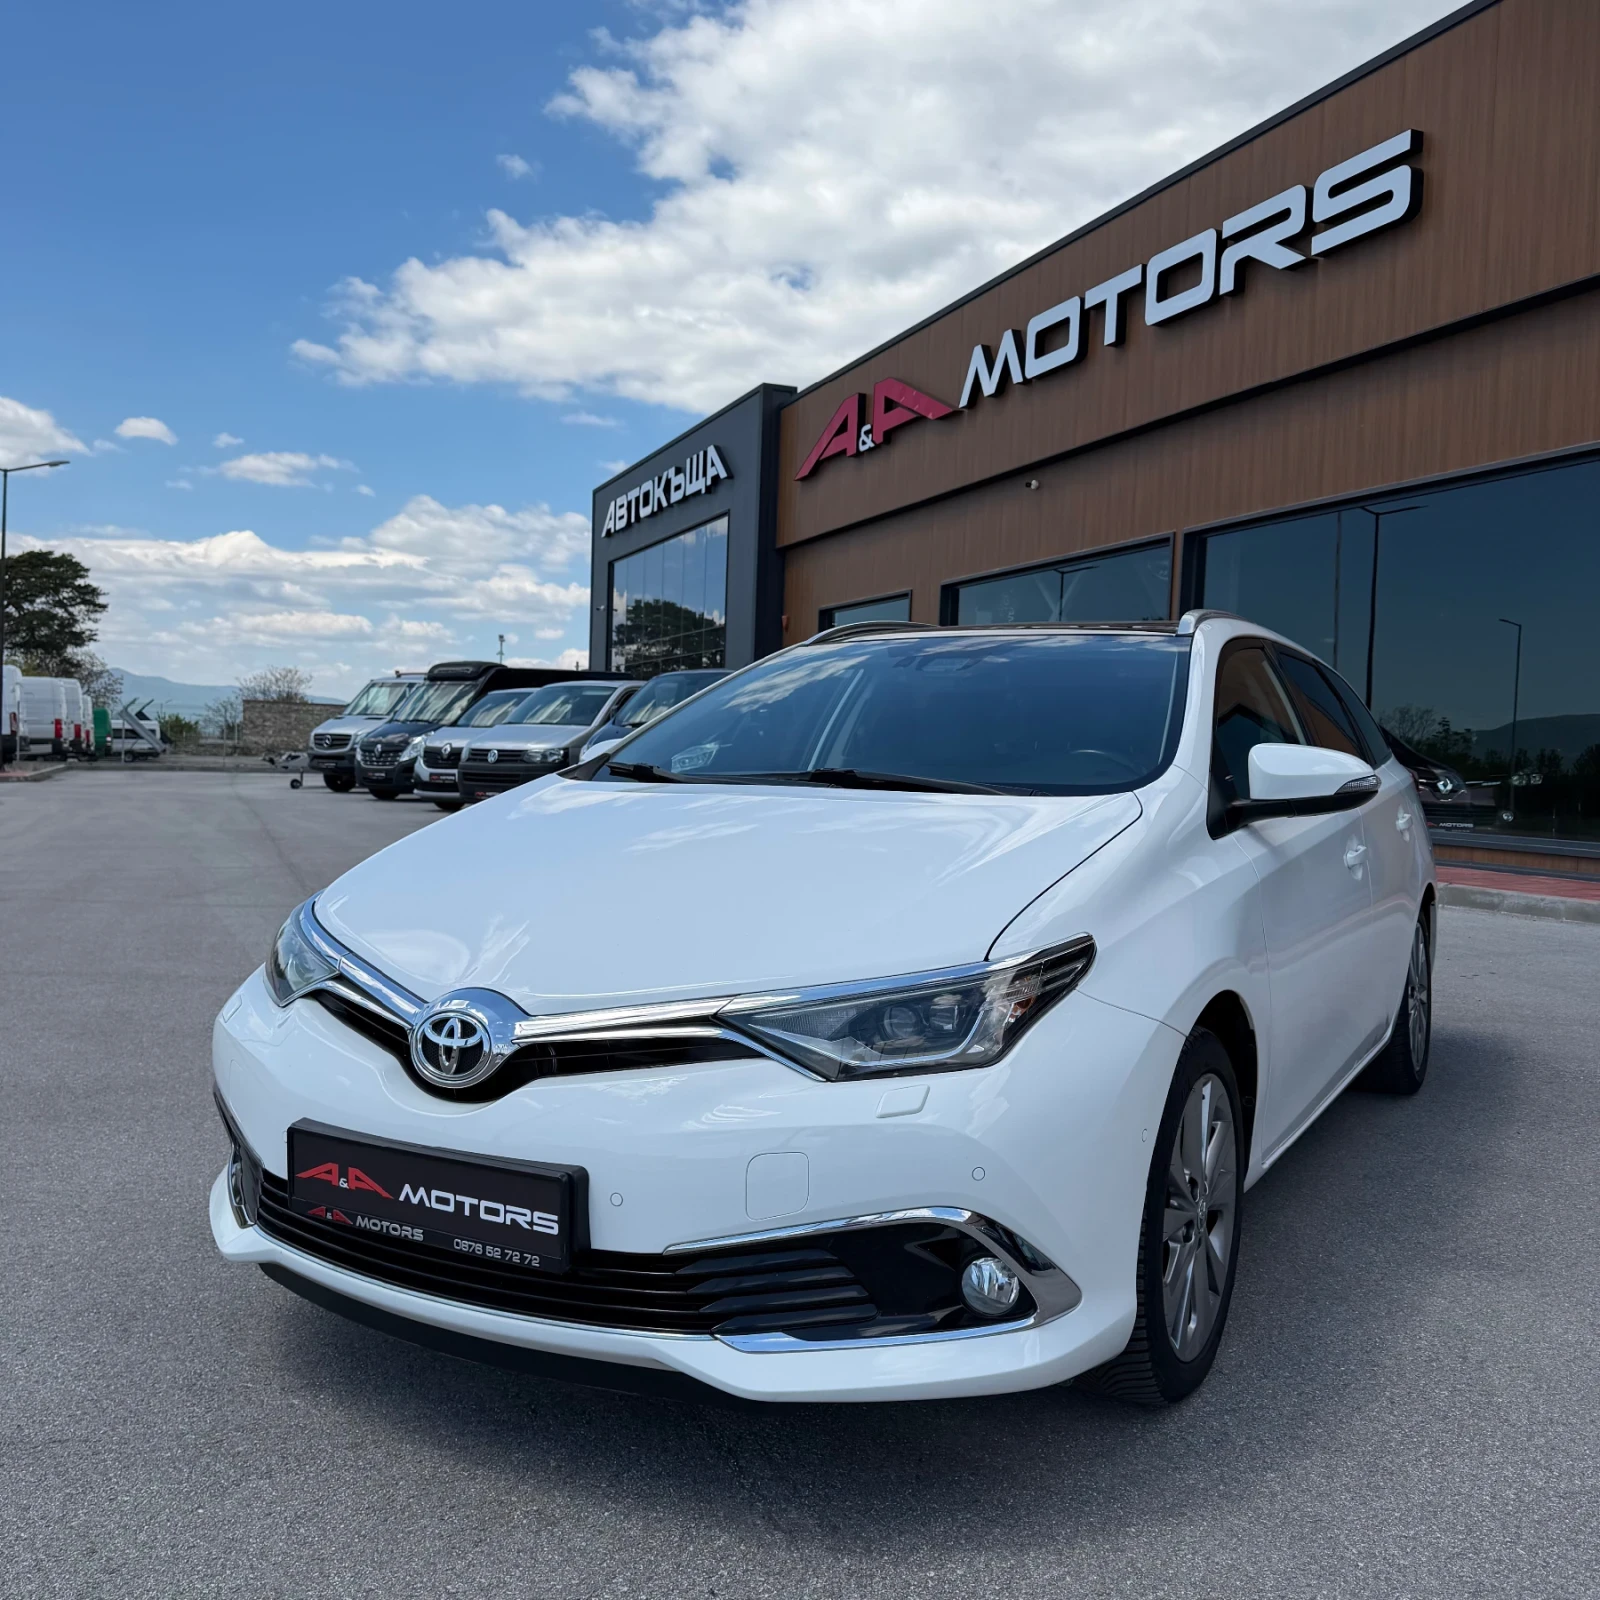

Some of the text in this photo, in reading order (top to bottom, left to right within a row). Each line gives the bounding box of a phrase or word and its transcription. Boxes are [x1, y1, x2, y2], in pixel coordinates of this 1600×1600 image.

[794, 128, 1422, 482] A&A MOTORS
[600, 443, 730, 539] АВТОКЪЩА
[295, 1162, 559, 1236] A&A MOTORS
[355, 1215, 424, 1242] MOTORS
[504, 1249, 521, 1263] 72
[523, 1253, 540, 1267] 72
